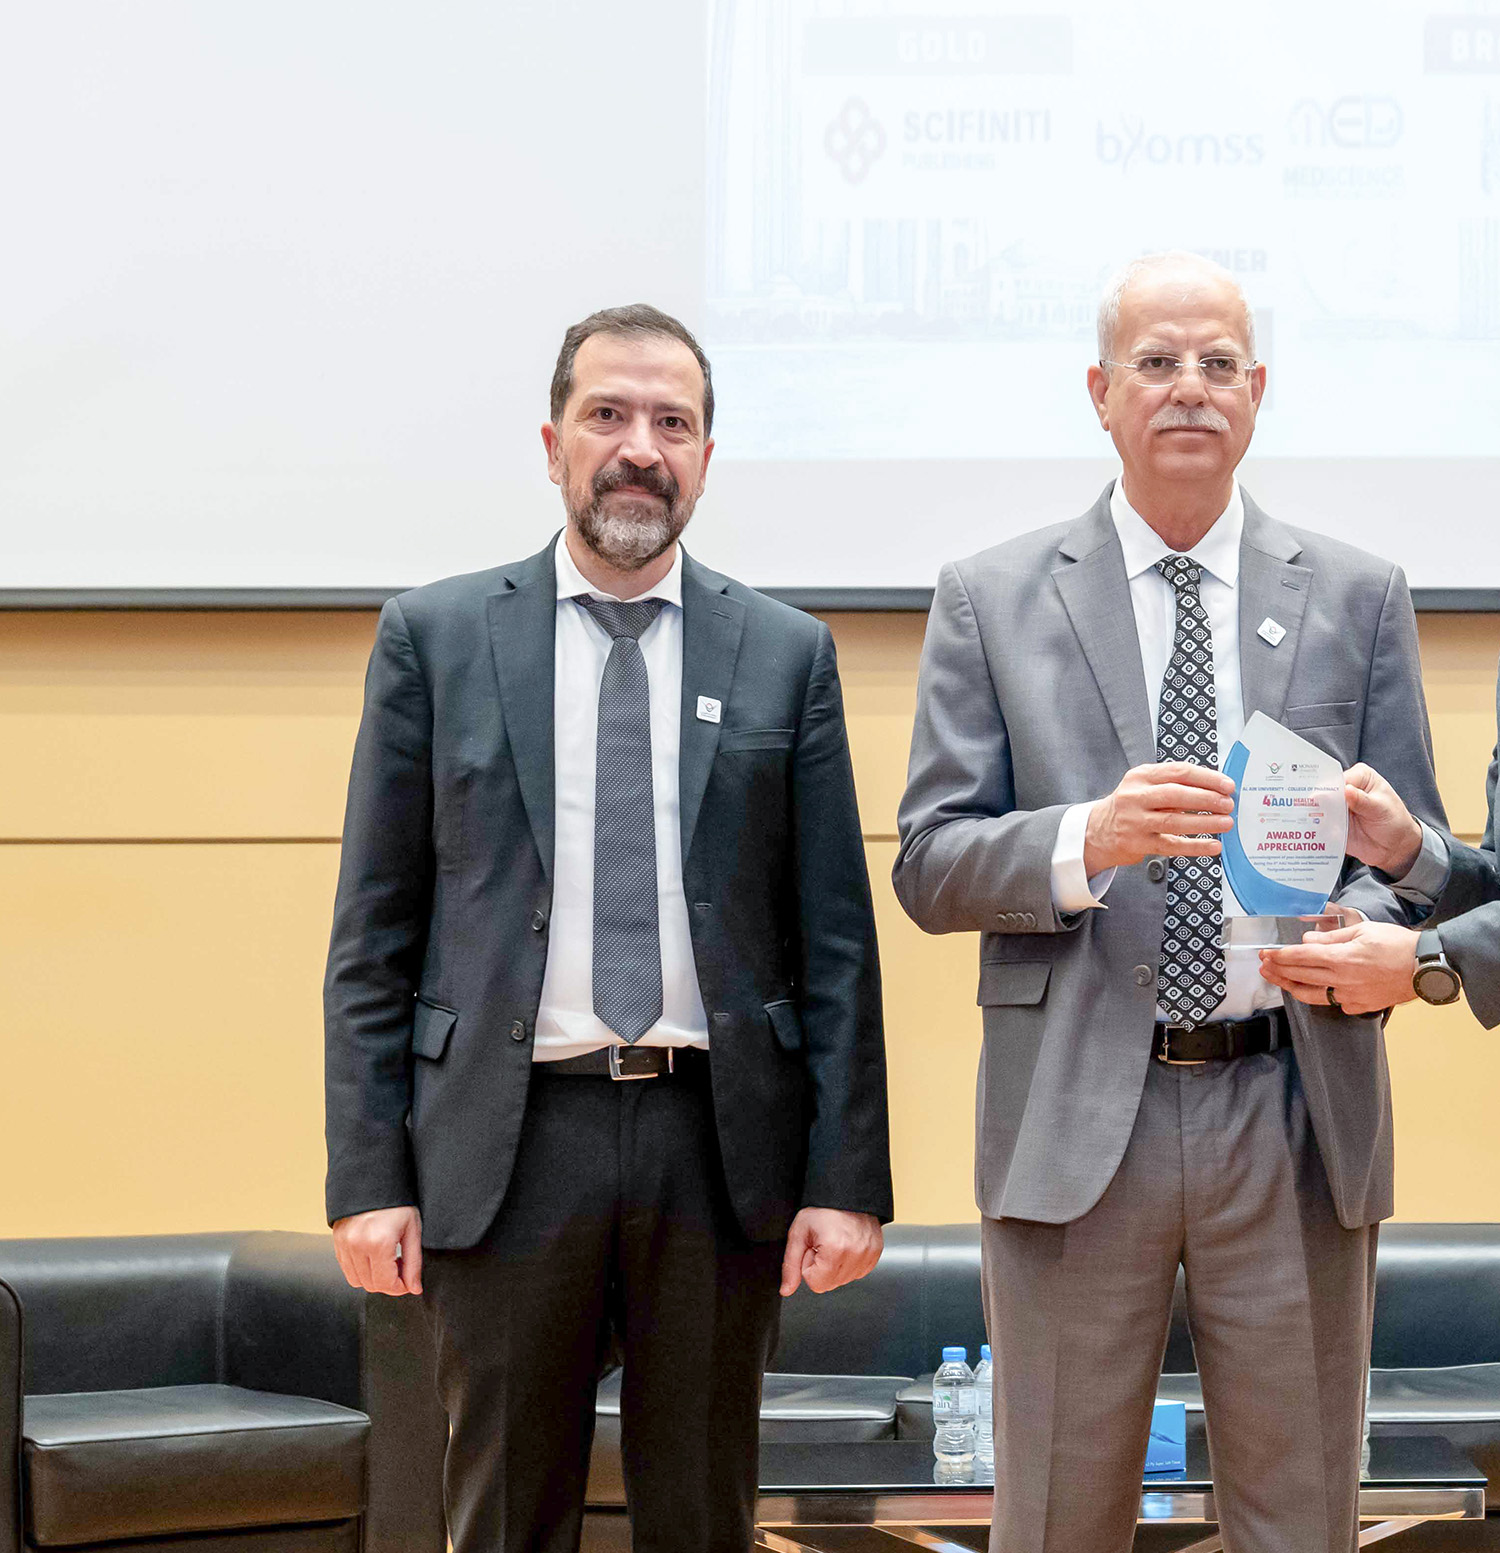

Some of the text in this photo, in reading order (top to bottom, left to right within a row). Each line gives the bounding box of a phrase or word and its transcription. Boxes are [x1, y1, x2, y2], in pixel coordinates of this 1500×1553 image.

[899, 30, 987, 63] GOLD
[903, 108, 1052, 144] SCIFINITI
[1271, 797, 1293, 807] AAU
[1266, 831, 1317, 840] AWARD OF
[1256, 842, 1326, 851] APPRECIATION
